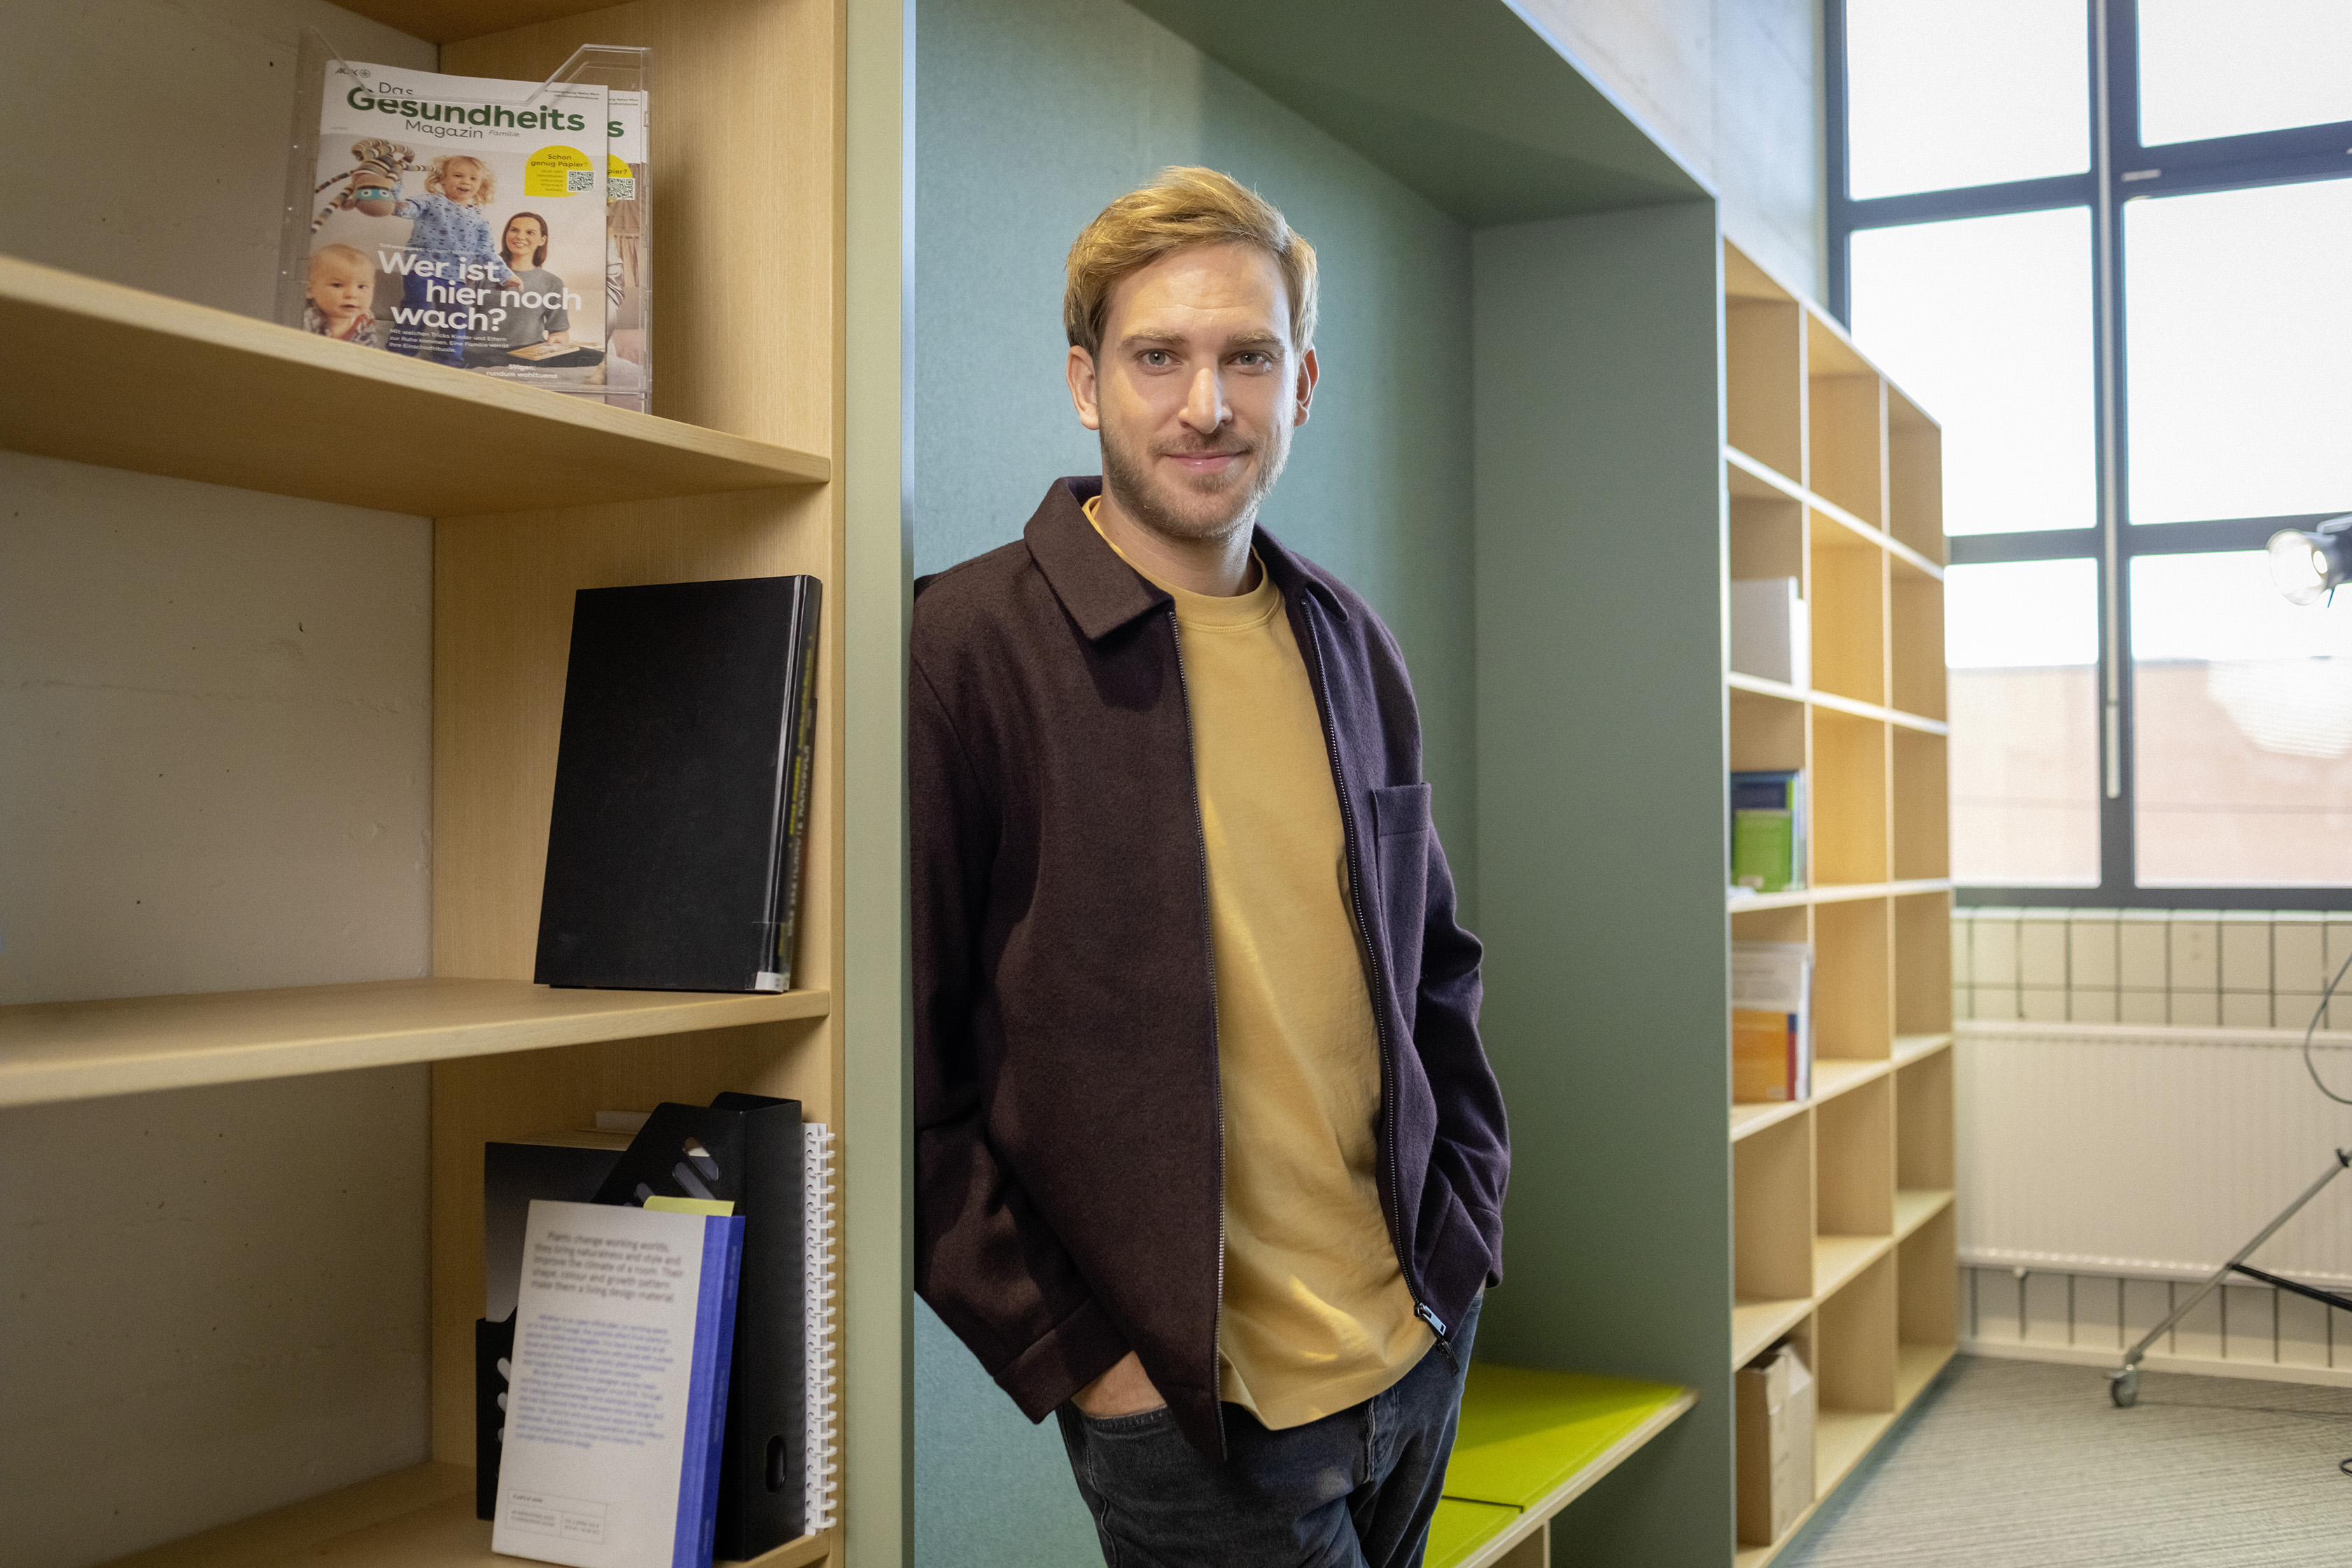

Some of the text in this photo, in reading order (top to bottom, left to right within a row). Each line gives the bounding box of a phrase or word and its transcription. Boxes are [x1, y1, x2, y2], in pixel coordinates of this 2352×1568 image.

[379, 81, 414, 96] Das
[346, 86, 586, 132] Gesundheits
[405, 119, 519, 139] Magazin Familie
[377, 250, 500, 282] Wer ist
[426, 279, 582, 311] hier noch
[391, 306, 507, 332] wach?
[507, 363, 536, 372] Singen:
